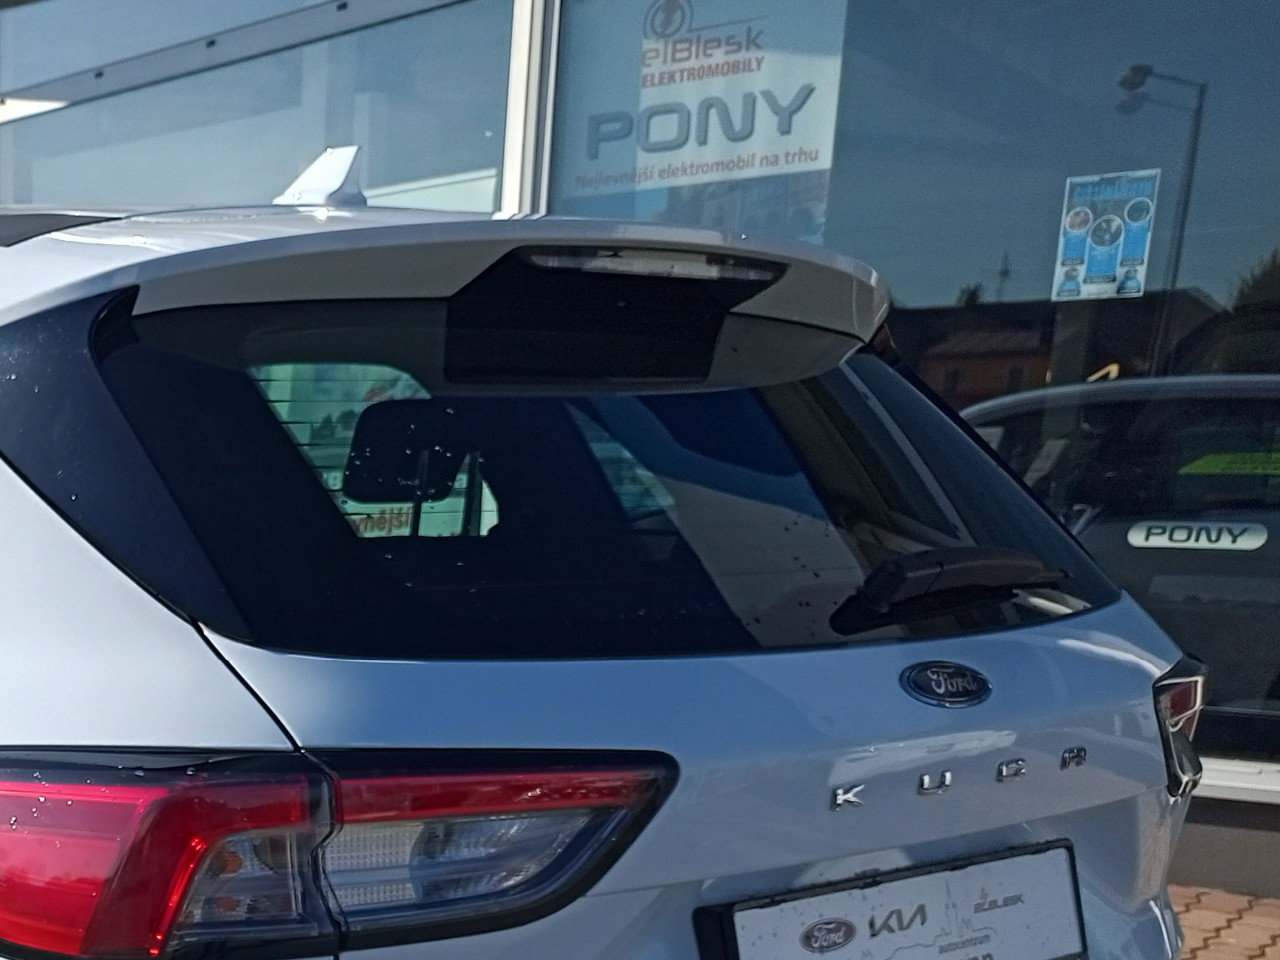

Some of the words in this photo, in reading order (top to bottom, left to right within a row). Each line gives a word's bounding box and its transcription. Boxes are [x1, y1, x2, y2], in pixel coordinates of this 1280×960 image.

[642, 55, 765, 88] ELEKTROMOBILY
[586, 83, 816, 160] PONY
[657, 153, 756, 179] elektromobil
[759, 153, 779, 168] na
[784, 146, 819, 165] trhu
[1144, 524, 1249, 544] PONY
[926, 667, 979, 695] Ford
